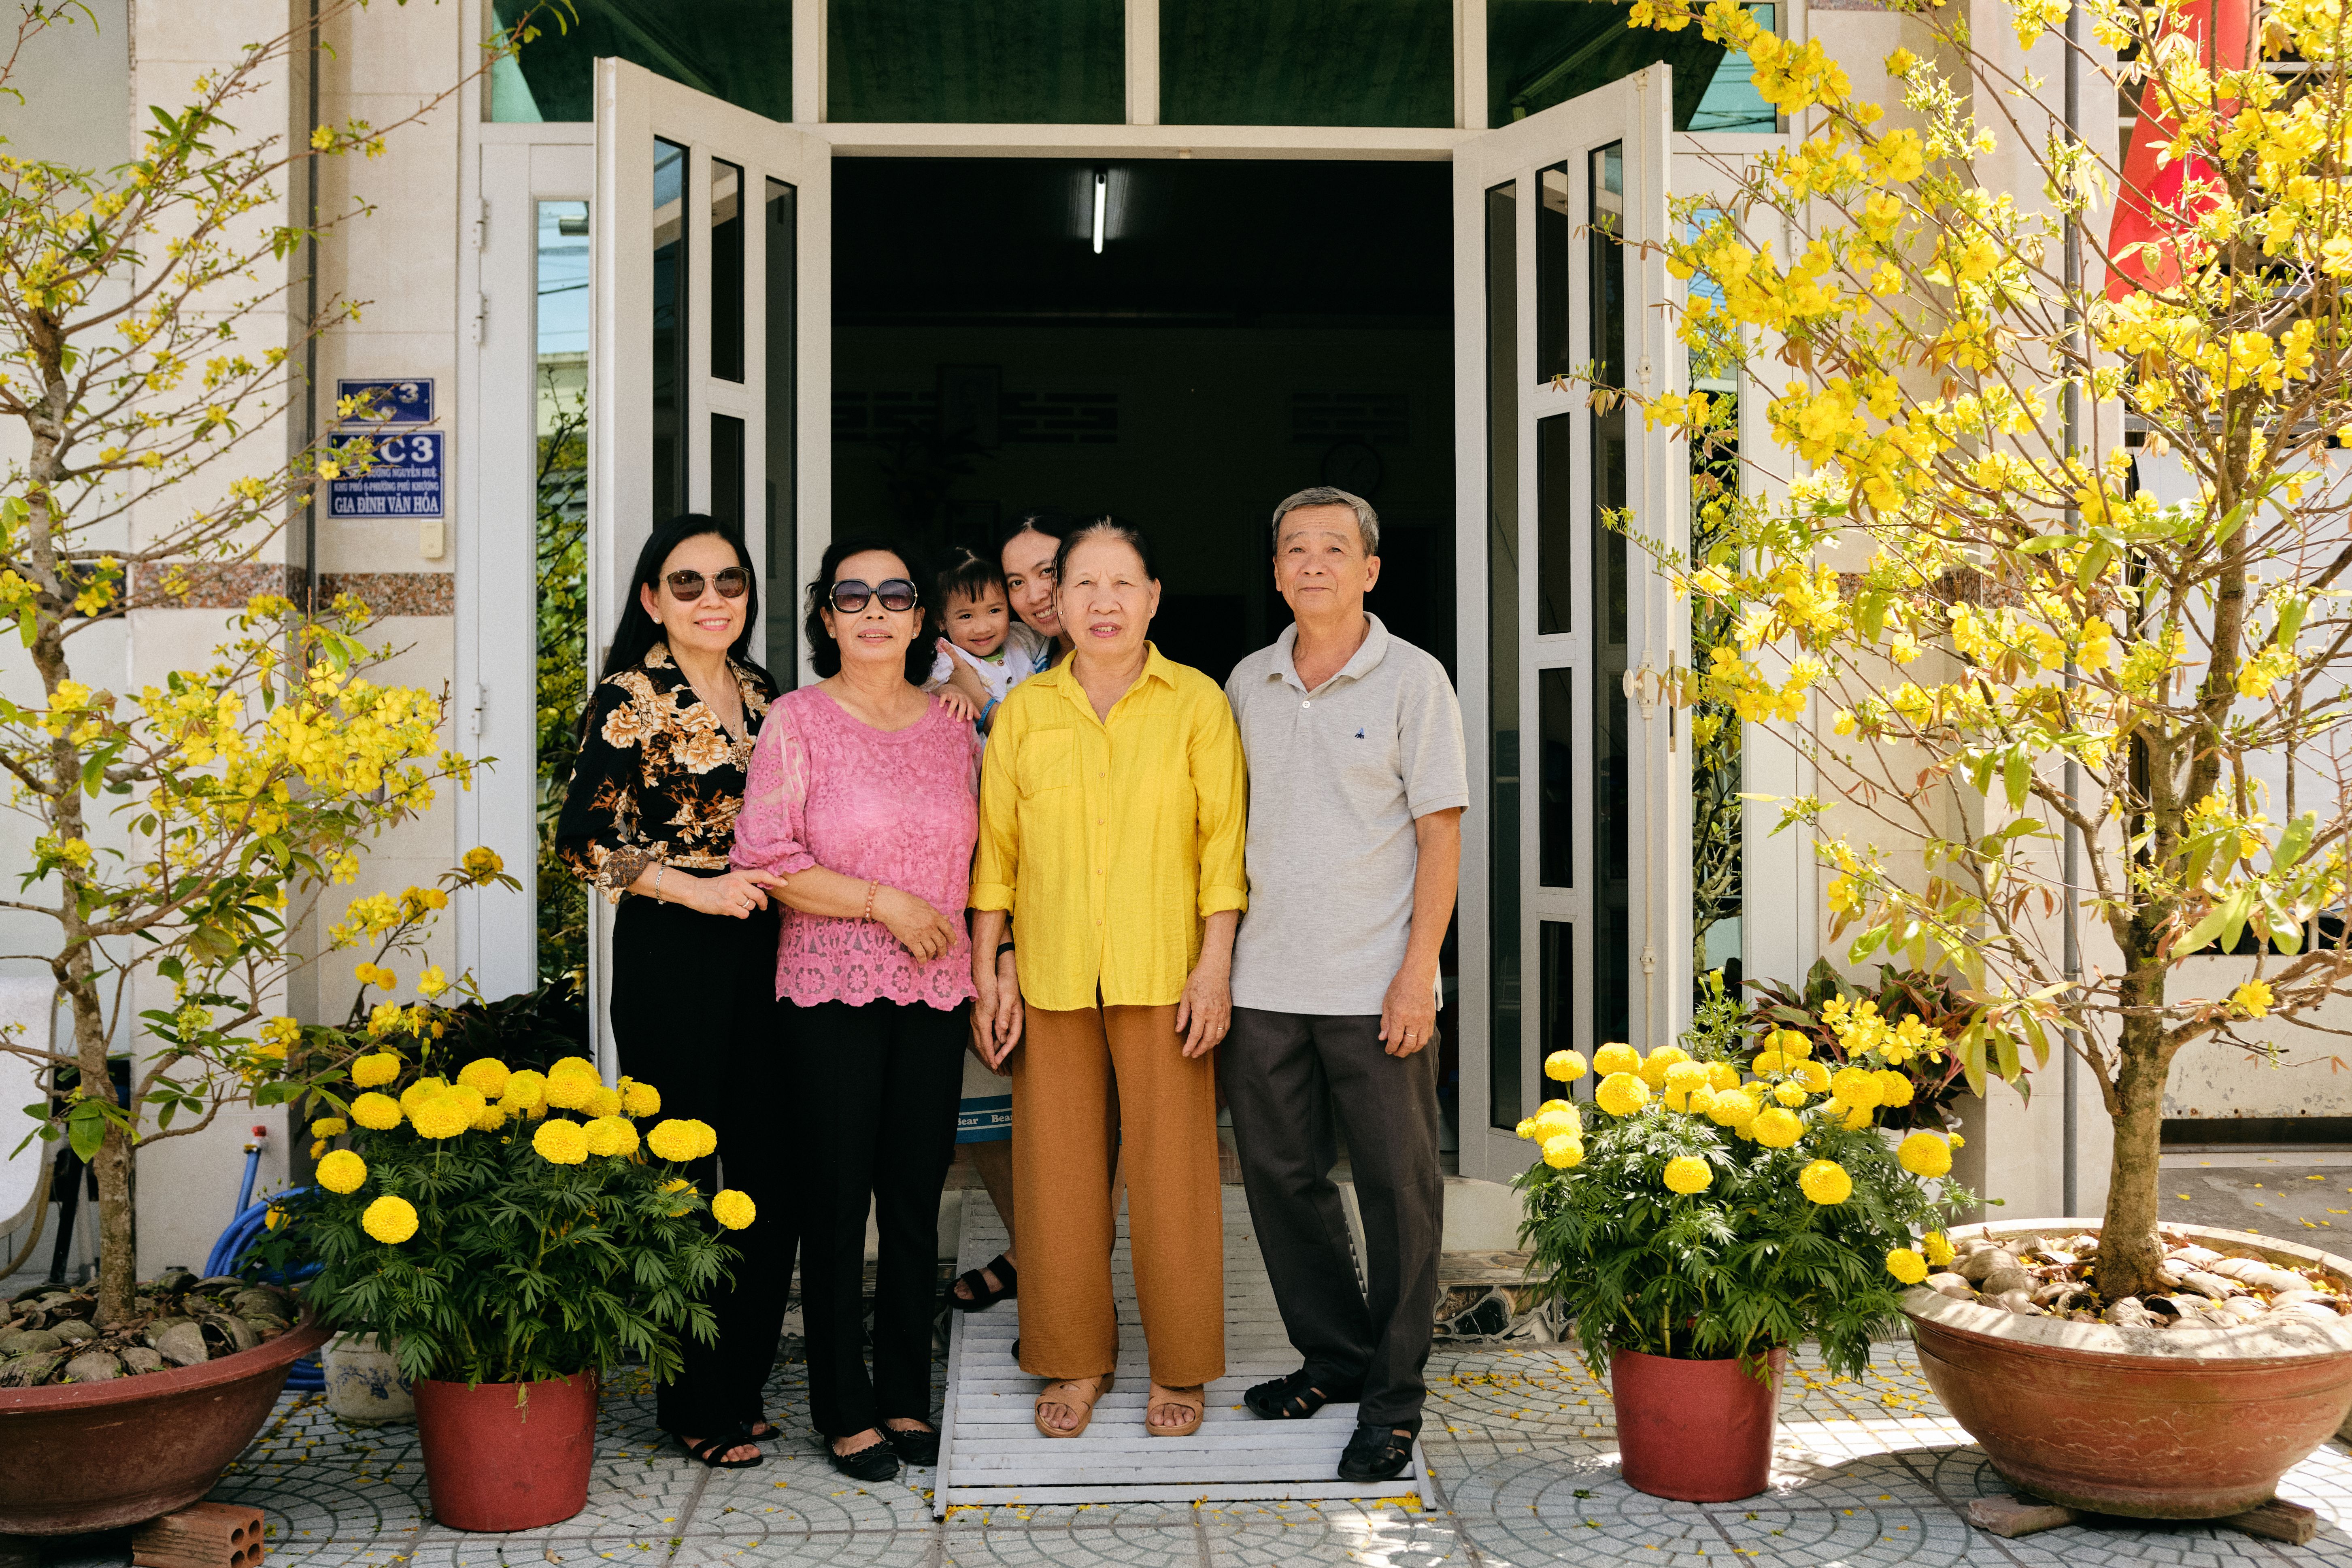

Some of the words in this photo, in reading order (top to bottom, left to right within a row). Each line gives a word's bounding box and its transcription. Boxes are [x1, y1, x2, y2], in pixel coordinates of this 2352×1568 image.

[392, 464, 421, 477] NGUYỄN
[334, 497, 355, 513] GIA
[357, 492, 386, 513] ĐÌNH
[387, 493, 410, 513] VĂN
[413, 491, 439, 513] HÓA
